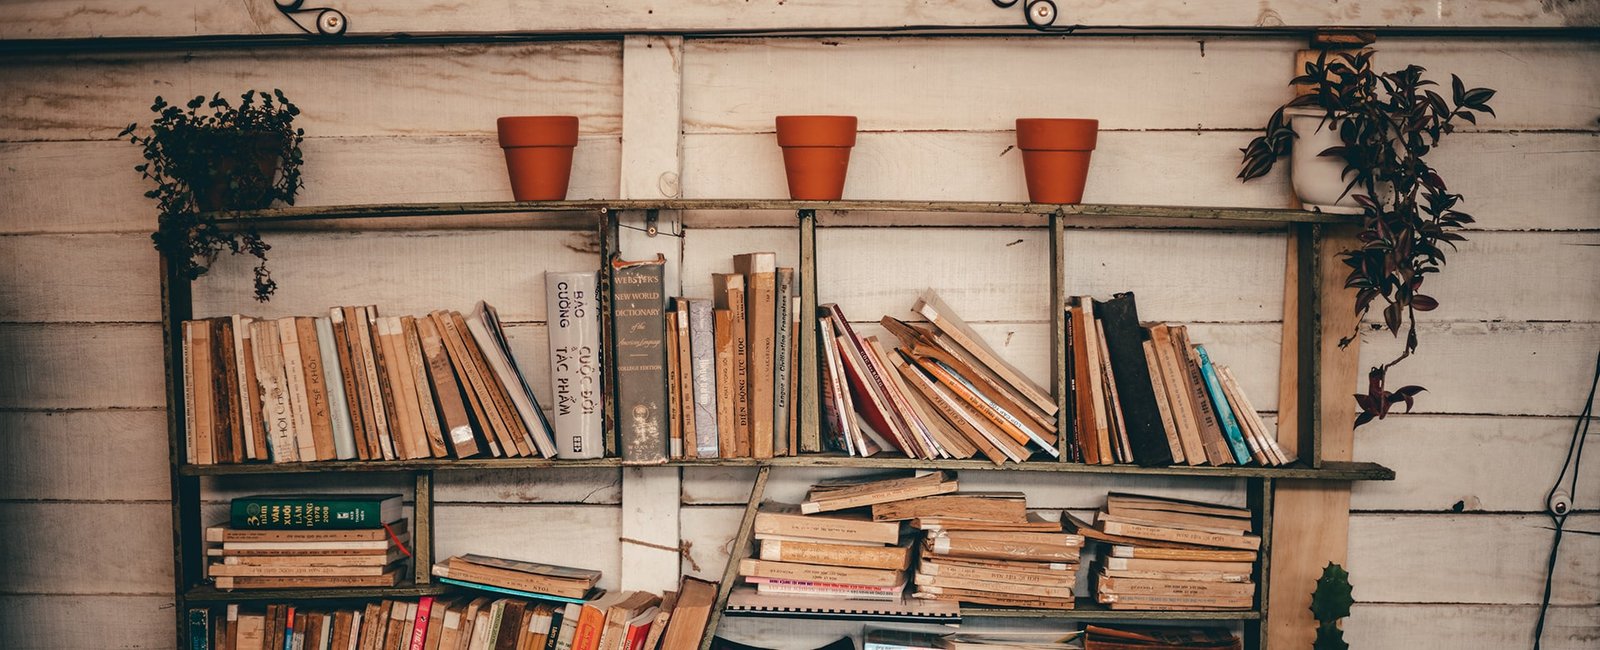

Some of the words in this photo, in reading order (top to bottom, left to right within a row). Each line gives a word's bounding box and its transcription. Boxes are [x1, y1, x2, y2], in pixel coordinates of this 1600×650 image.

[557, 281, 572, 328] CƯỜNG
[615, 293, 631, 301] NEW
[632, 292, 659, 300] WORLD
[615, 309, 660, 317] DICTIONARY
[555, 346, 573, 372] TÁC
[738, 379, 746, 402] ĐỘNG
[272, 506, 280, 522] VĂN
[283, 505, 291, 525] XUÔI
